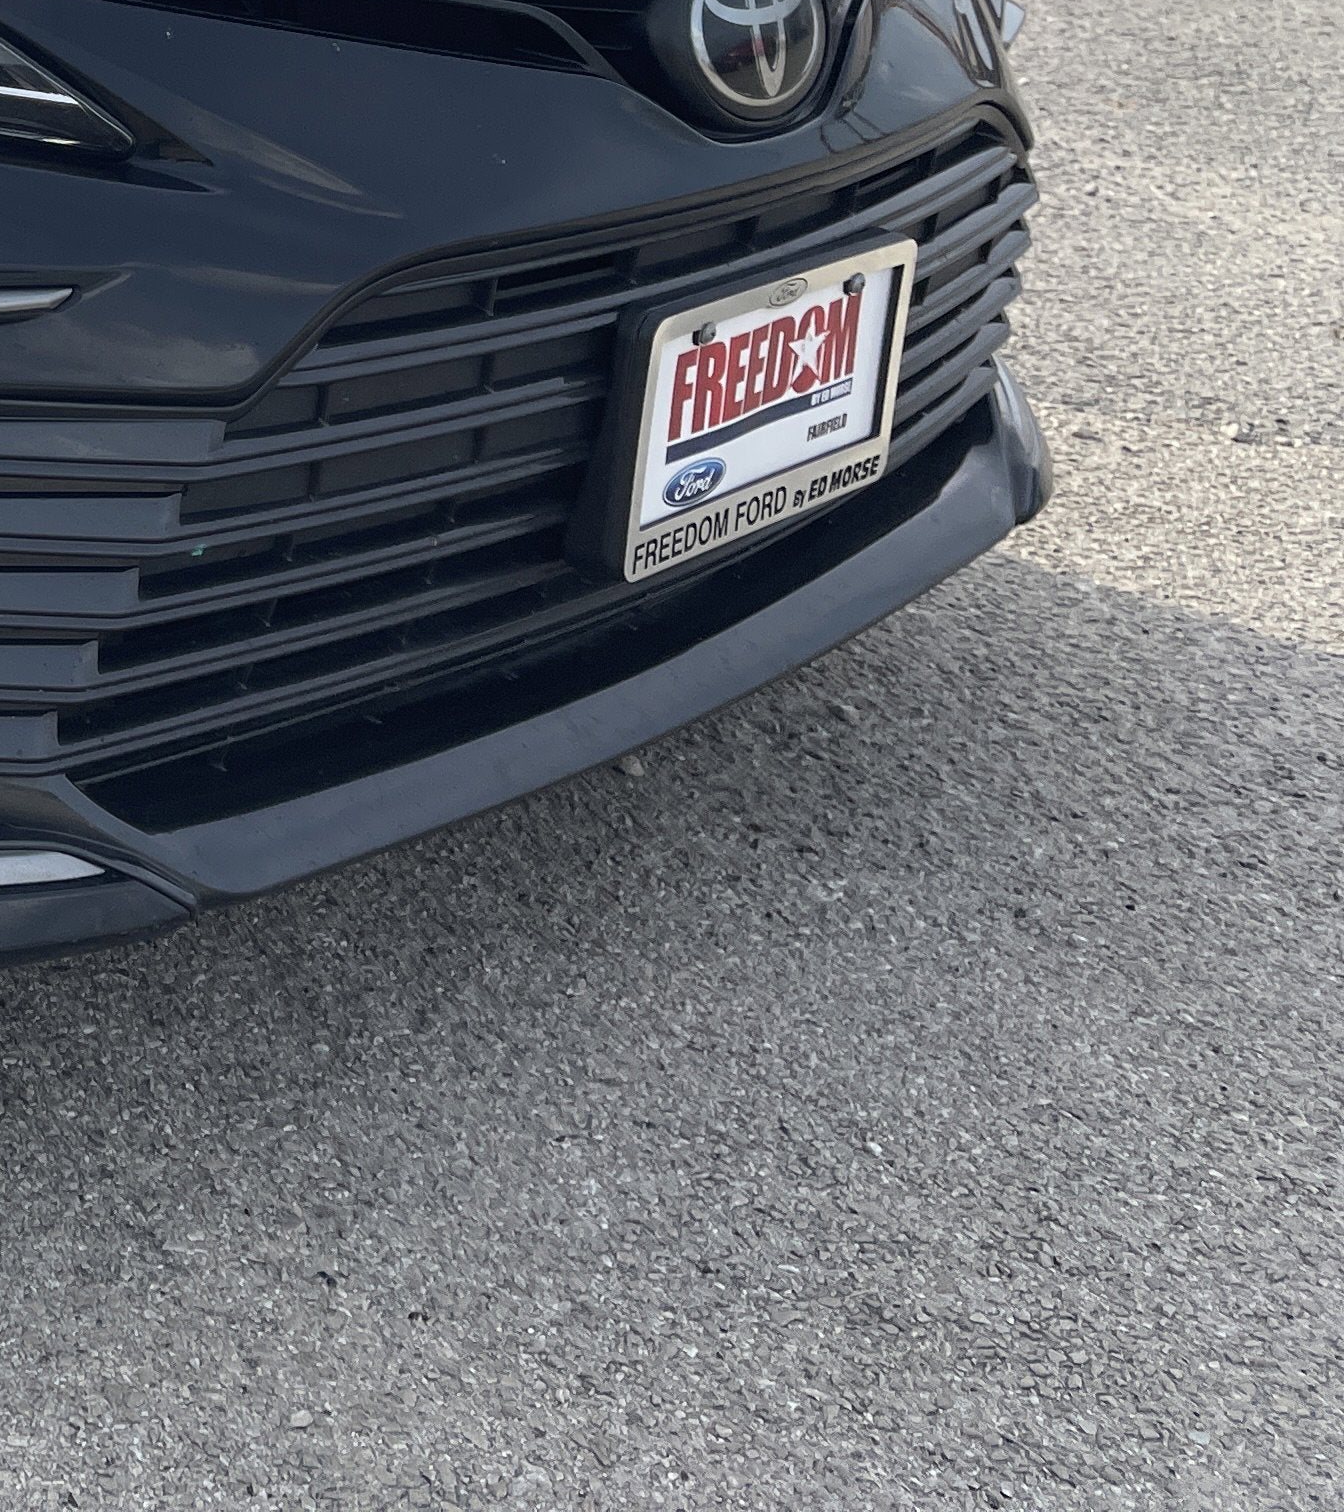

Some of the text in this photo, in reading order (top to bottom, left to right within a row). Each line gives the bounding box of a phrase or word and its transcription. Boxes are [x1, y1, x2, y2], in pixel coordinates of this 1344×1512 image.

[668, 293, 863, 442] FREEDOM
[632, 508, 730, 575] FREEDOM
[735, 486, 786, 531] FORD
[808, 475, 828, 502] ED
[828, 454, 881, 493] MORSE
